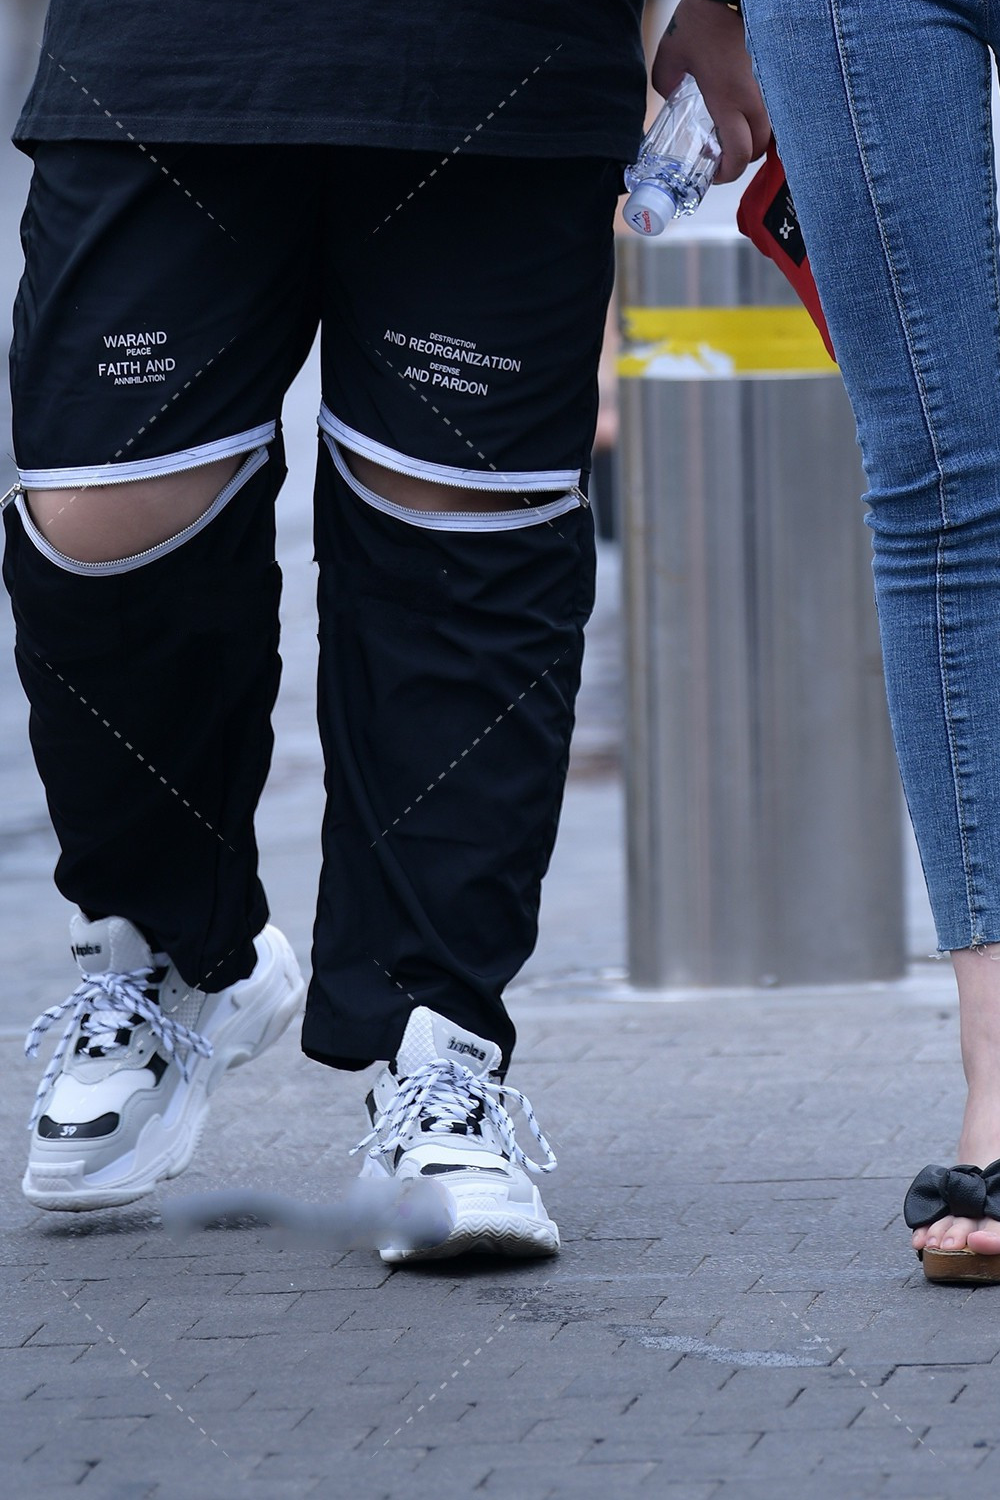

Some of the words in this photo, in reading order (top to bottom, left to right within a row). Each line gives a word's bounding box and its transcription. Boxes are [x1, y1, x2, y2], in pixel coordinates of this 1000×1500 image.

[103, 331, 167, 349] WARAND
[429, 332, 477, 350] DESTRUCTION
[126, 347, 152, 357] PEACE
[383, 329, 407, 346] AND
[408, 336, 522, 373] REORGANIZATION
[98, 361, 141, 377] FAITH
[145, 358, 176, 373] AND
[429, 361, 461, 376] DEFENSE
[113, 374, 166, 386] ANNIHILATION
[403, 366, 430, 383] AND
[432, 373, 489, 397] PARDON
[60, 1125, 77, 1137] 39
